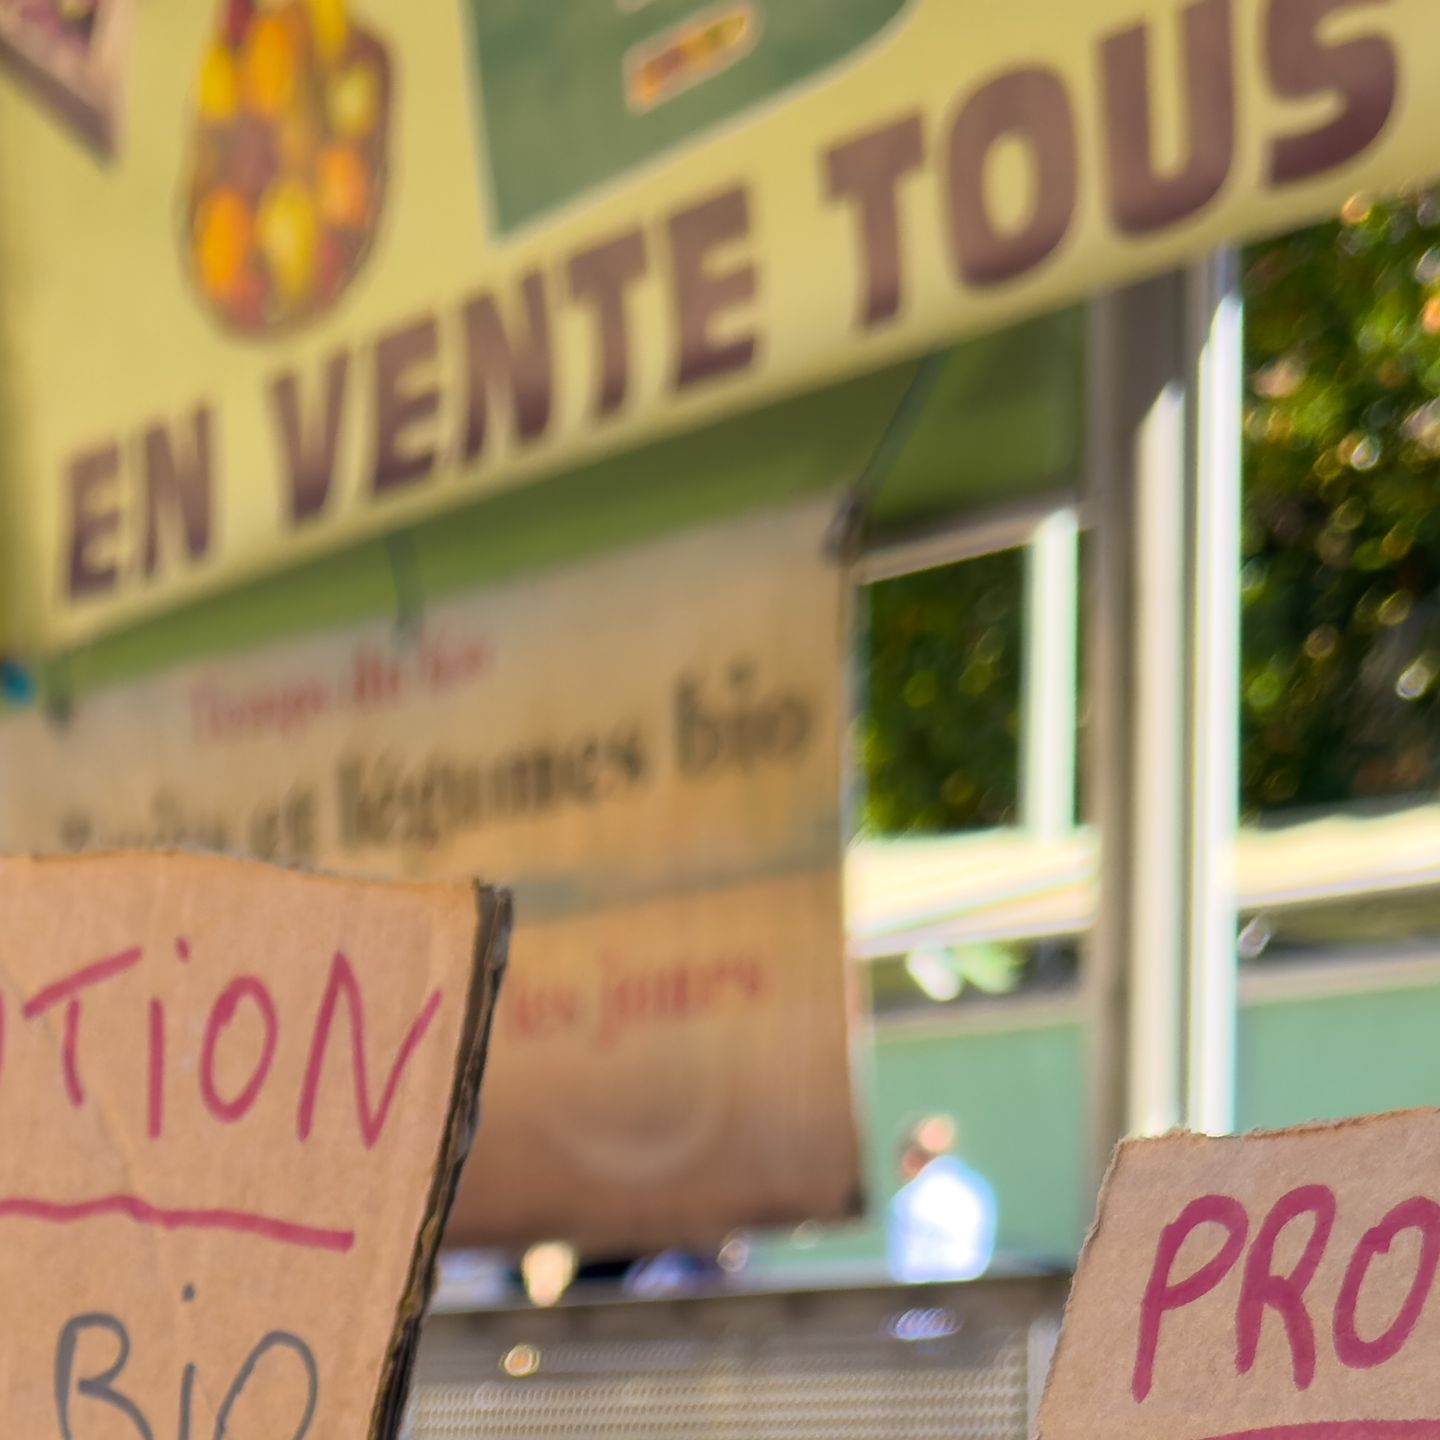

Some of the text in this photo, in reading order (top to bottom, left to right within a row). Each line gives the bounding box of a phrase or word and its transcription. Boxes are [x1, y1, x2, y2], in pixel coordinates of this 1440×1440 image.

[64, 0, 1399, 598] EN VENTE TOUS
